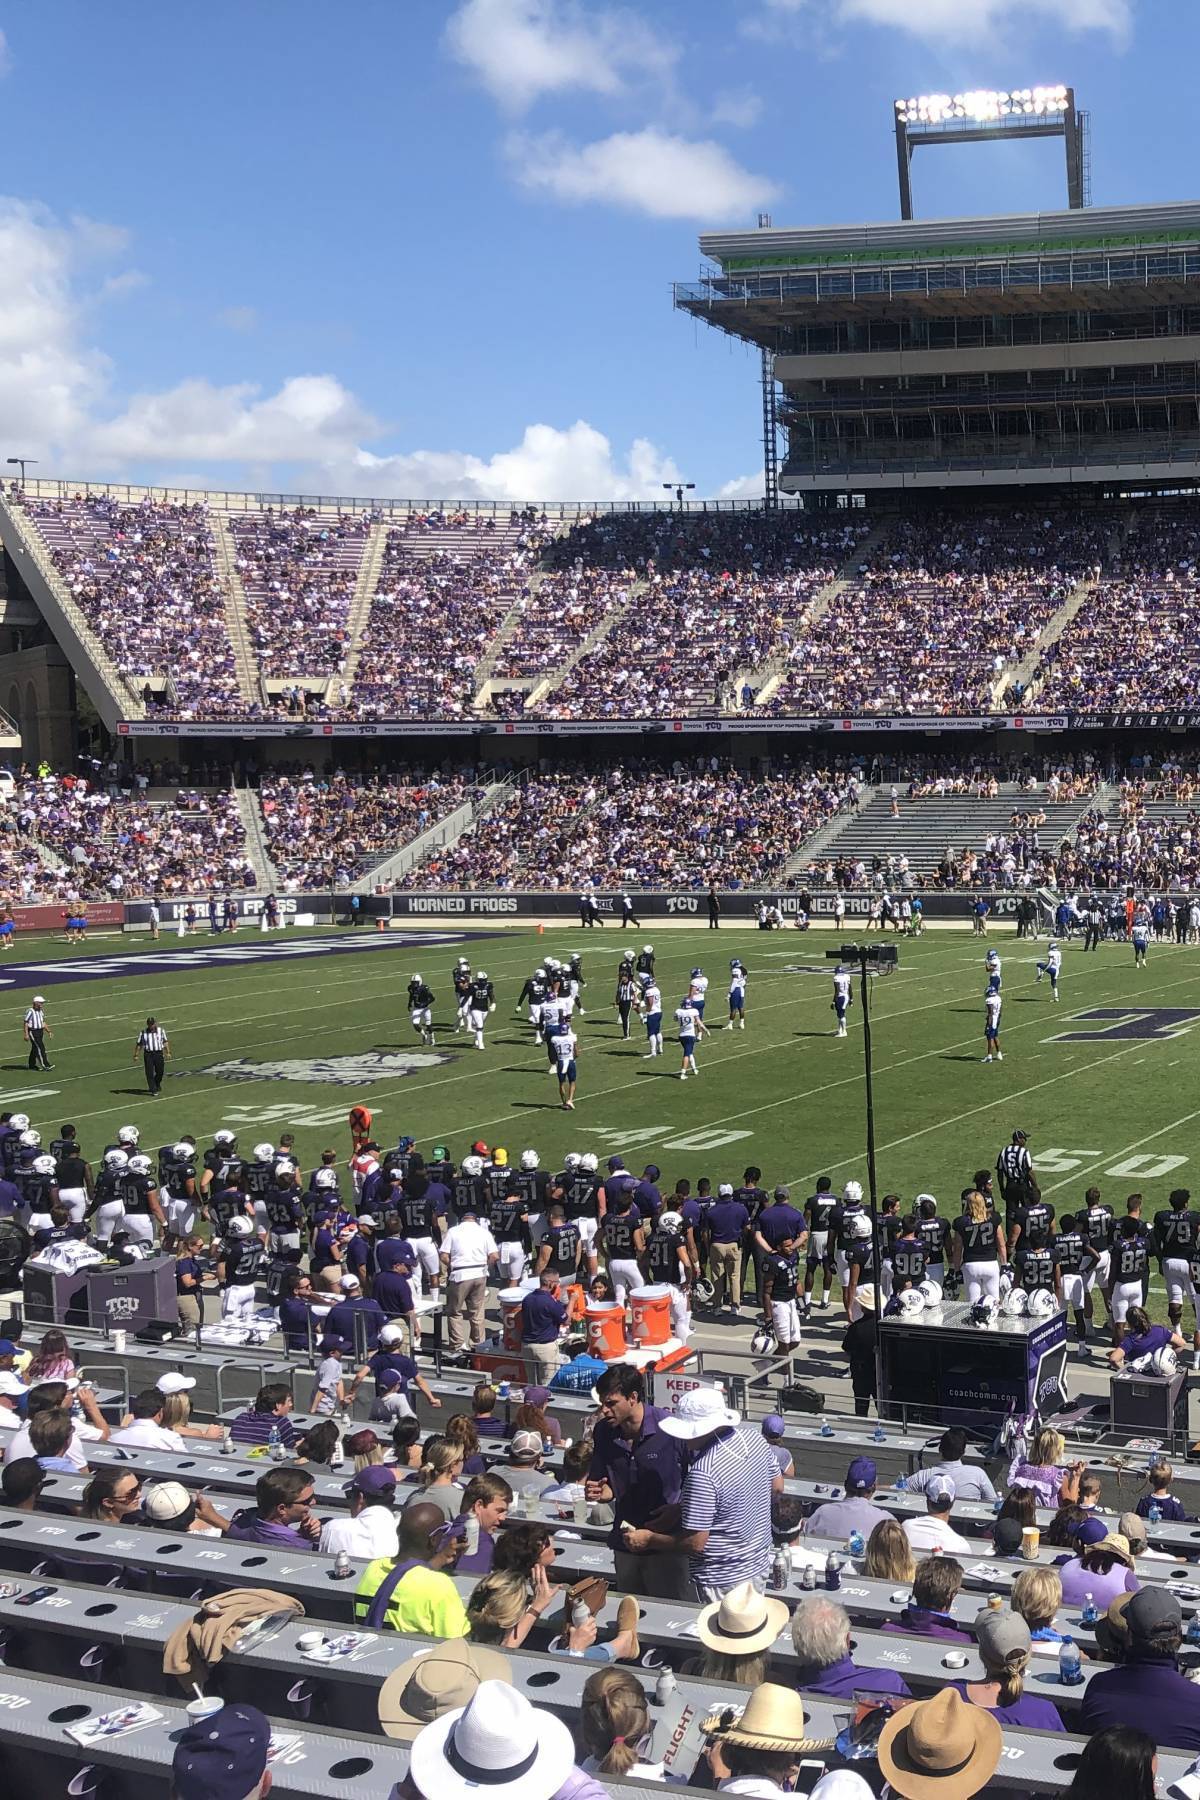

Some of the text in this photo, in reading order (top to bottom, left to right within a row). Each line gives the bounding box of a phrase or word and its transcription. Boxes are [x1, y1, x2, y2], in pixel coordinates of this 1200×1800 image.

[408, 898, 518, 912] HORNED FROGS
[666, 896, 698, 912] TCU
[554, 1043, 572, 1056] 13
[456, 1186, 478, 1207] 81
[604, 1224, 631, 1247] 82
[965, 1222, 995, 1248] 72
[1164, 1220, 1192, 1244] 79
[649, 1241, 670, 1267] 31
[895, 1252, 925, 1277] 96
[1024, 1261, 1054, 1285] 32
[105, 1296, 140, 1314] TCU
[588, 1320, 602, 1338] G
[1032, 1320, 1063, 1345] coachcomm.com
[666, 1379, 700, 1391] KEEP
[949, 1388, 1018, 1402] coachcomm.com
[1038, 1376, 1058, 1403] TCU
[195, 1550, 227, 1560] TCU
[840, 1588, 870, 1597] TCU
[662, 1704, 694, 1766] FLIGHT
